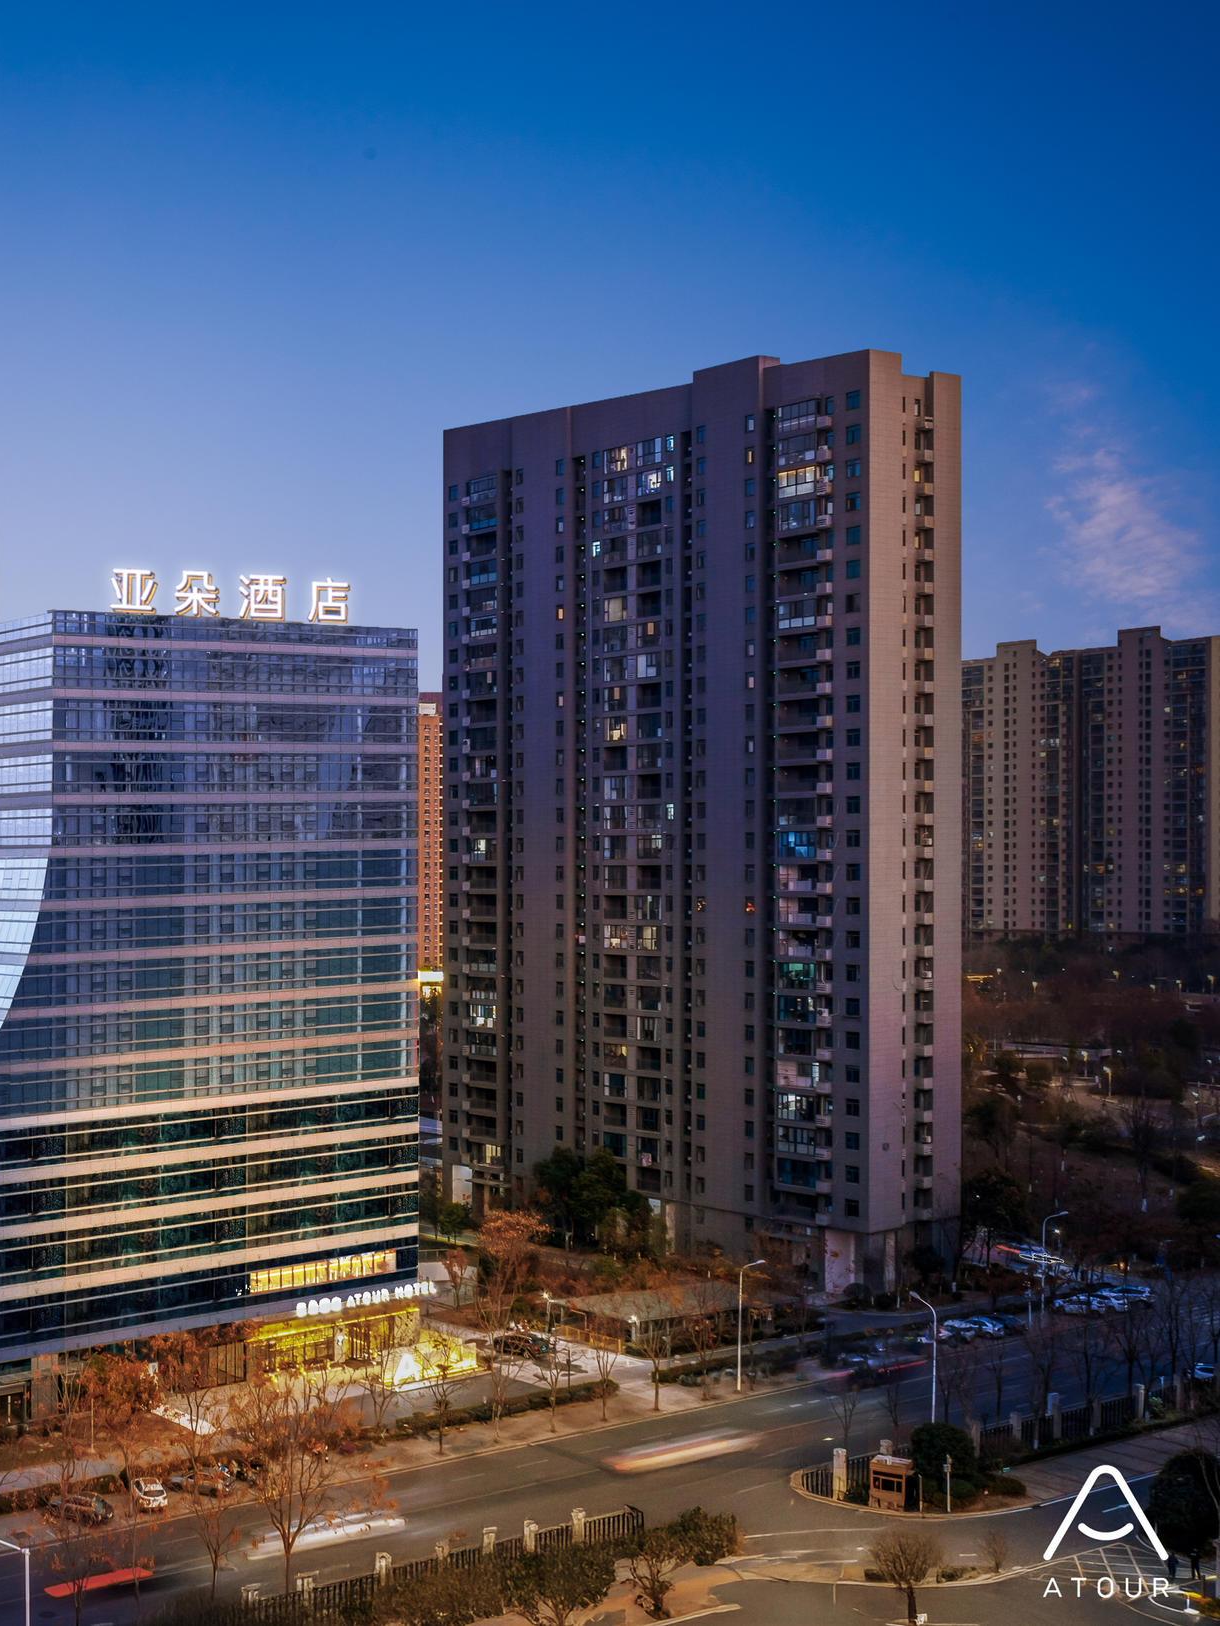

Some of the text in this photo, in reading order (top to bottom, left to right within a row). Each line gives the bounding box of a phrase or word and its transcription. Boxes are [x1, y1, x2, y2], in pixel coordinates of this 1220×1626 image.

[110, 568, 350, 623] 亚朵酒店
[346, 1288, 390, 1307] ATOUR
[394, 1281, 437, 1299] HOTEL
